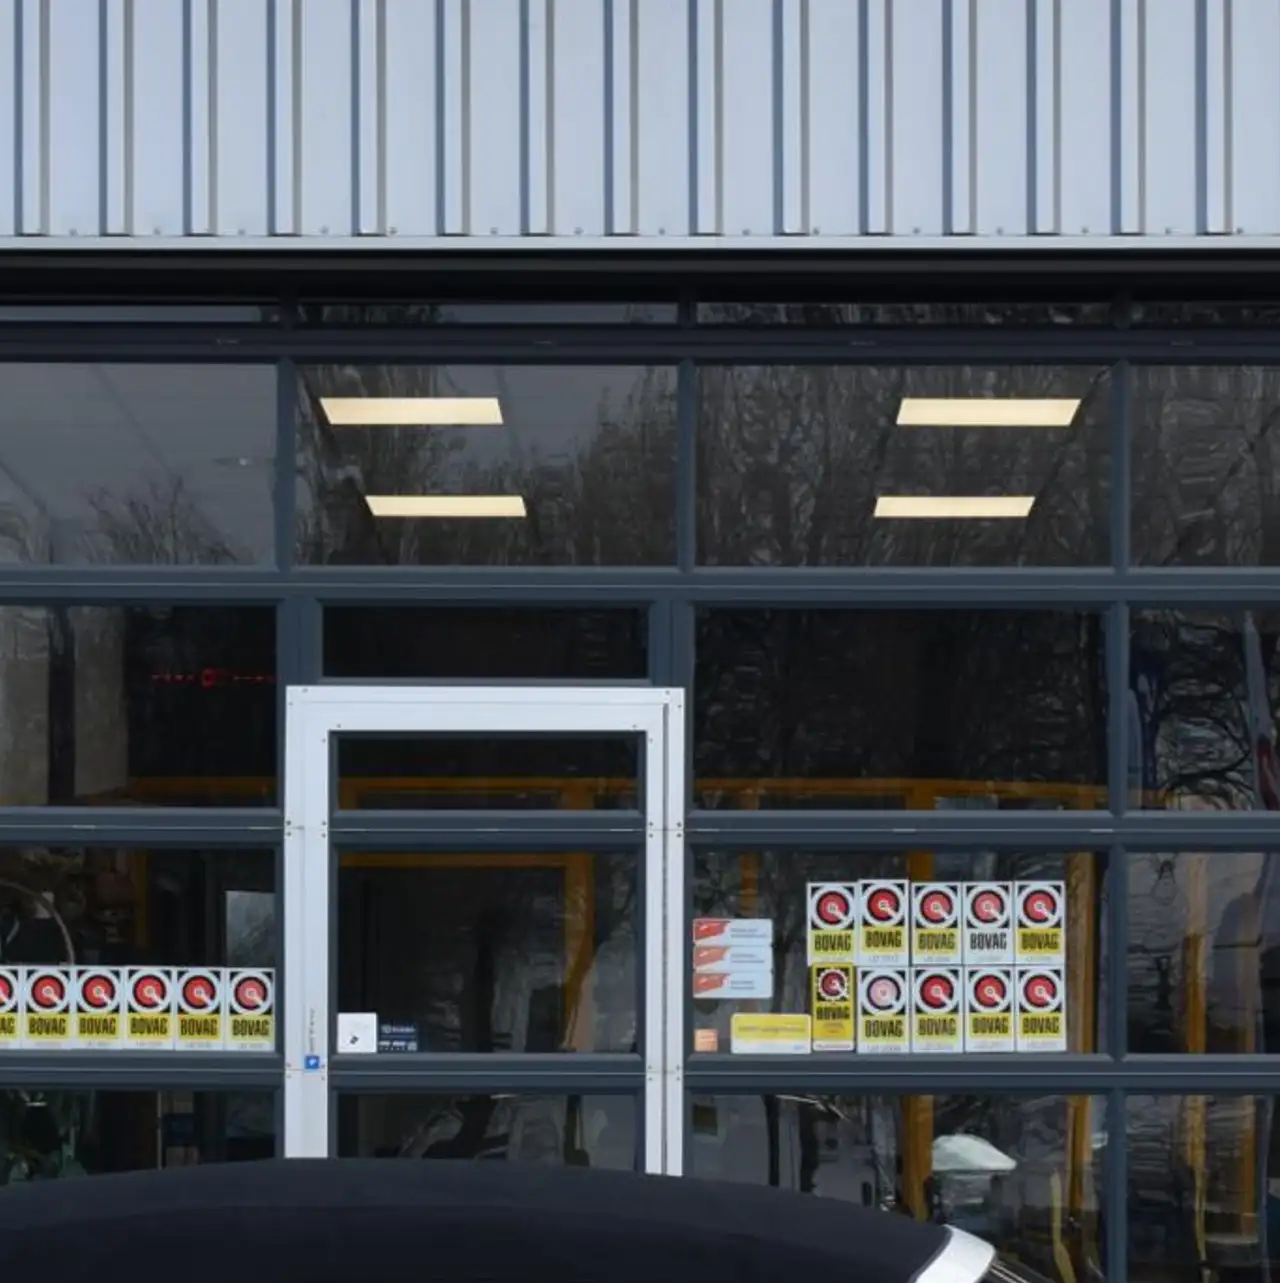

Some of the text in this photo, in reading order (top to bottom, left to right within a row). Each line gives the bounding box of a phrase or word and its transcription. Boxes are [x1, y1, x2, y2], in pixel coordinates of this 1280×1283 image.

[814, 933, 852, 951] BOVAG
[865, 930, 903, 948] BOVAG
[918, 933, 956, 950] BOVAG
[970, 932, 1007, 950] BOVAG
[1021, 932, 1060, 950] BOVAG
[28, 1017, 66, 1035] BOVAG
[79, 1017, 117, 1034] BOVAG
[130, 1018, 168, 1034] BOVAG
[180, 1018, 218, 1036] BOVAG
[232, 1019, 270, 1036] BOVAG
[864, 1019, 903, 1038] BOVAG
[918, 1018, 956, 1036] BOVAG
[972, 1015, 1009, 1034] BOVAG
[1022, 1016, 1060, 1034] BOVAG
